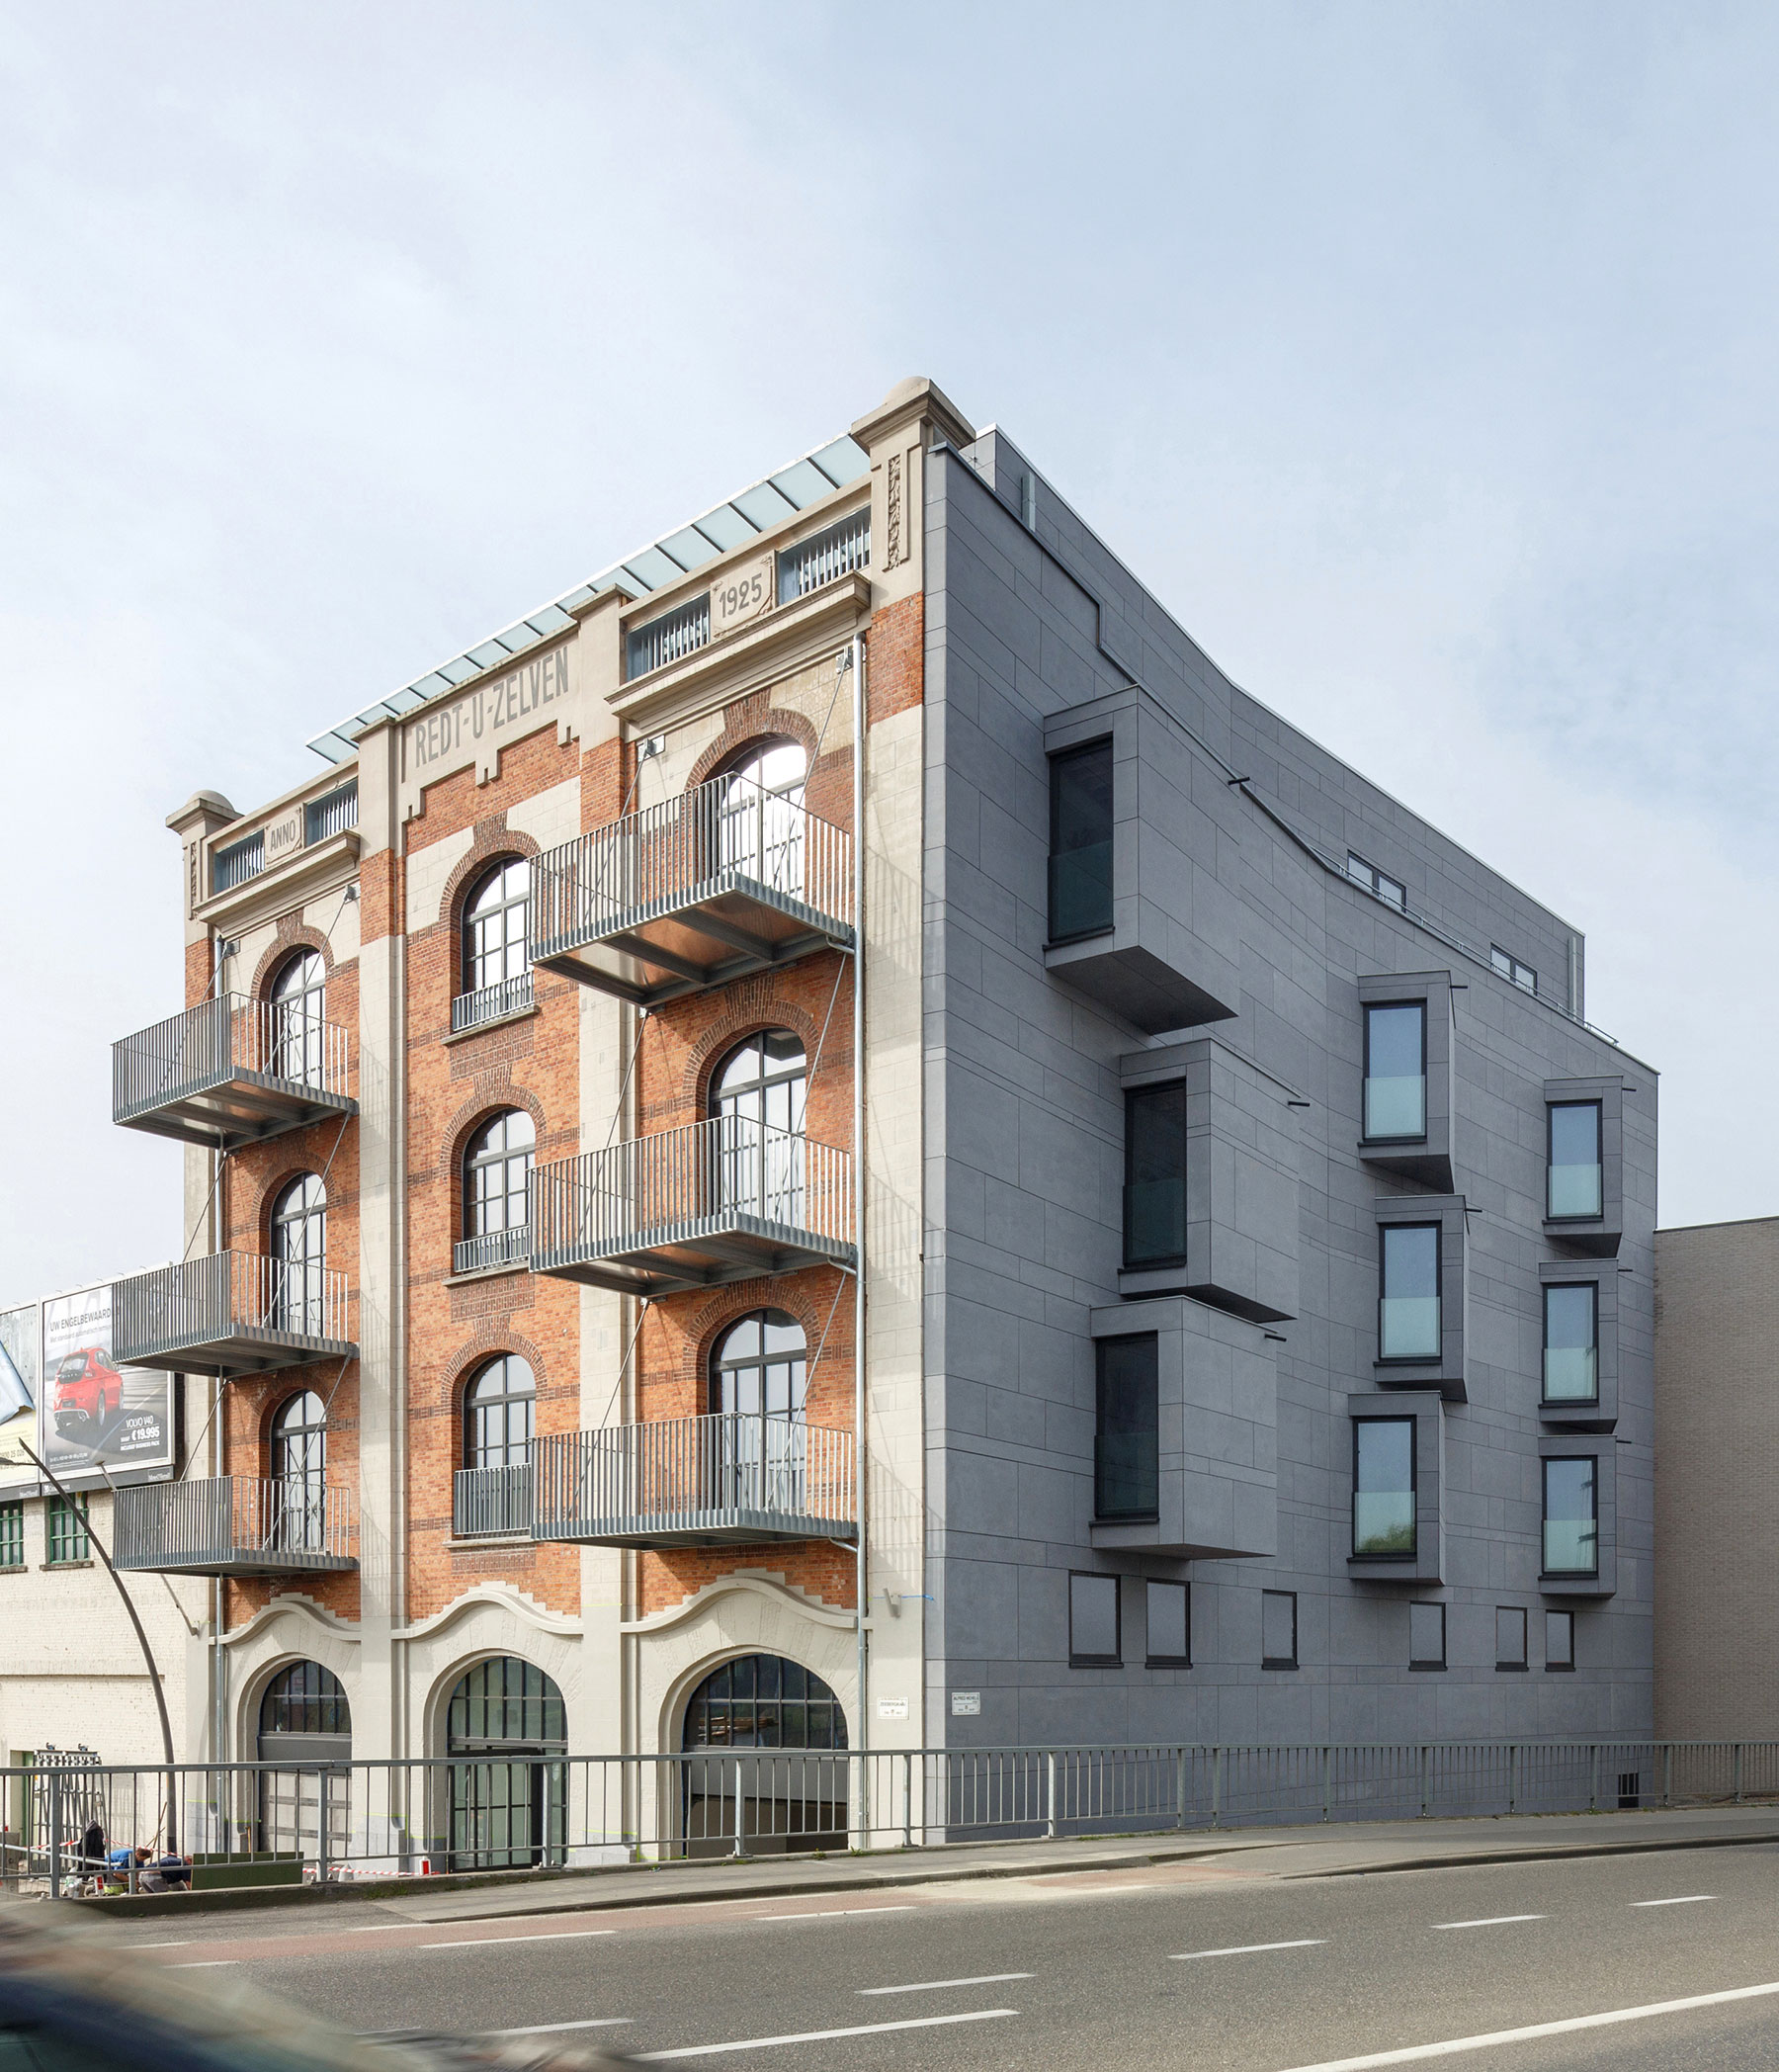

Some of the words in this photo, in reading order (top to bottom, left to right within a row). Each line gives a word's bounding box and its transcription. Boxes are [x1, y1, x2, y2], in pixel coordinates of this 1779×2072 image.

[719, 573, 762, 618] 1925
[270, 820, 296, 851] ANNO
[49, 1321, 61, 1332] UW
[61, 1308, 112, 1329] ENGELBEWAARD
[126, 1417, 143, 1428] VOLVO
[143, 1415, 154, 1425] V40
